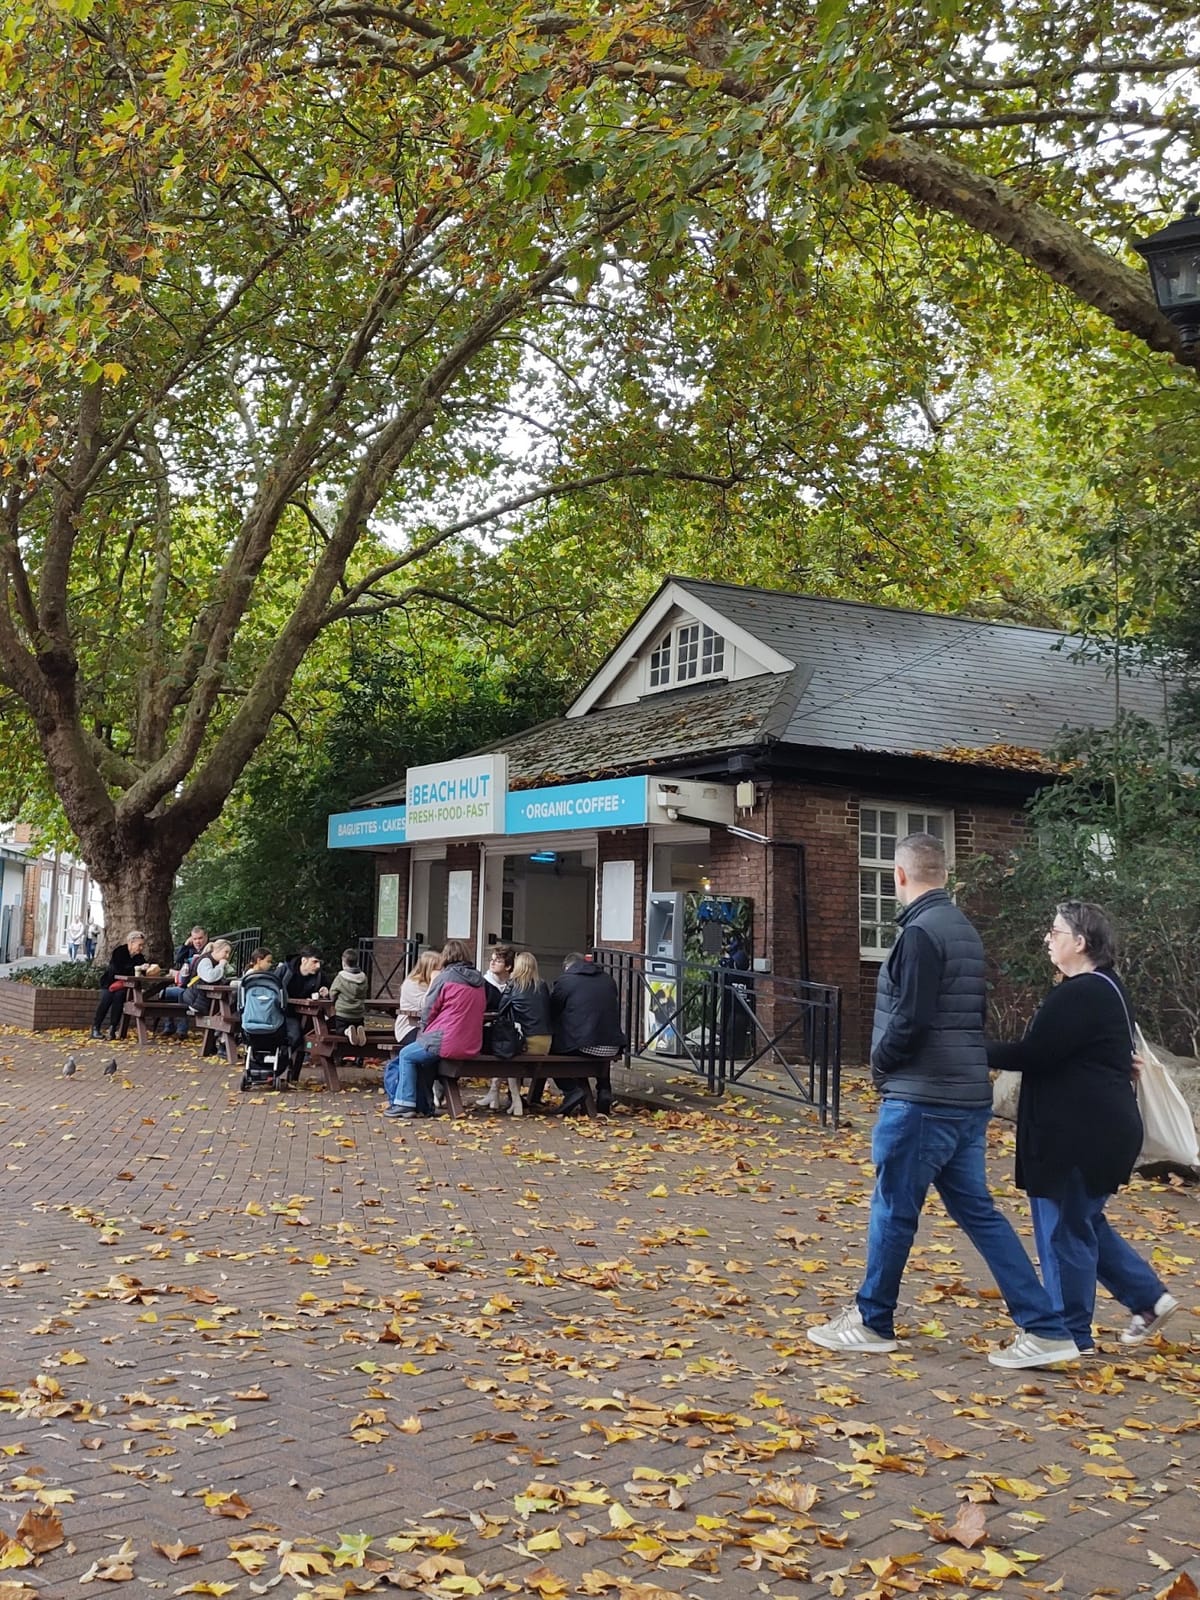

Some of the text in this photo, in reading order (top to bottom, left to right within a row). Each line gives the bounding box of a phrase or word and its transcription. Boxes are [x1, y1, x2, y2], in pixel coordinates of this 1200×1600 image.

[413, 780, 456, 806] BEACH
[460, 774, 490, 799] HUT
[408, 803, 490, 824] FRESH FOOD FAST
[526, 795, 619, 819] ORGANIC COFFEE
[337, 817, 406, 836] BAGUETTES CAKES
